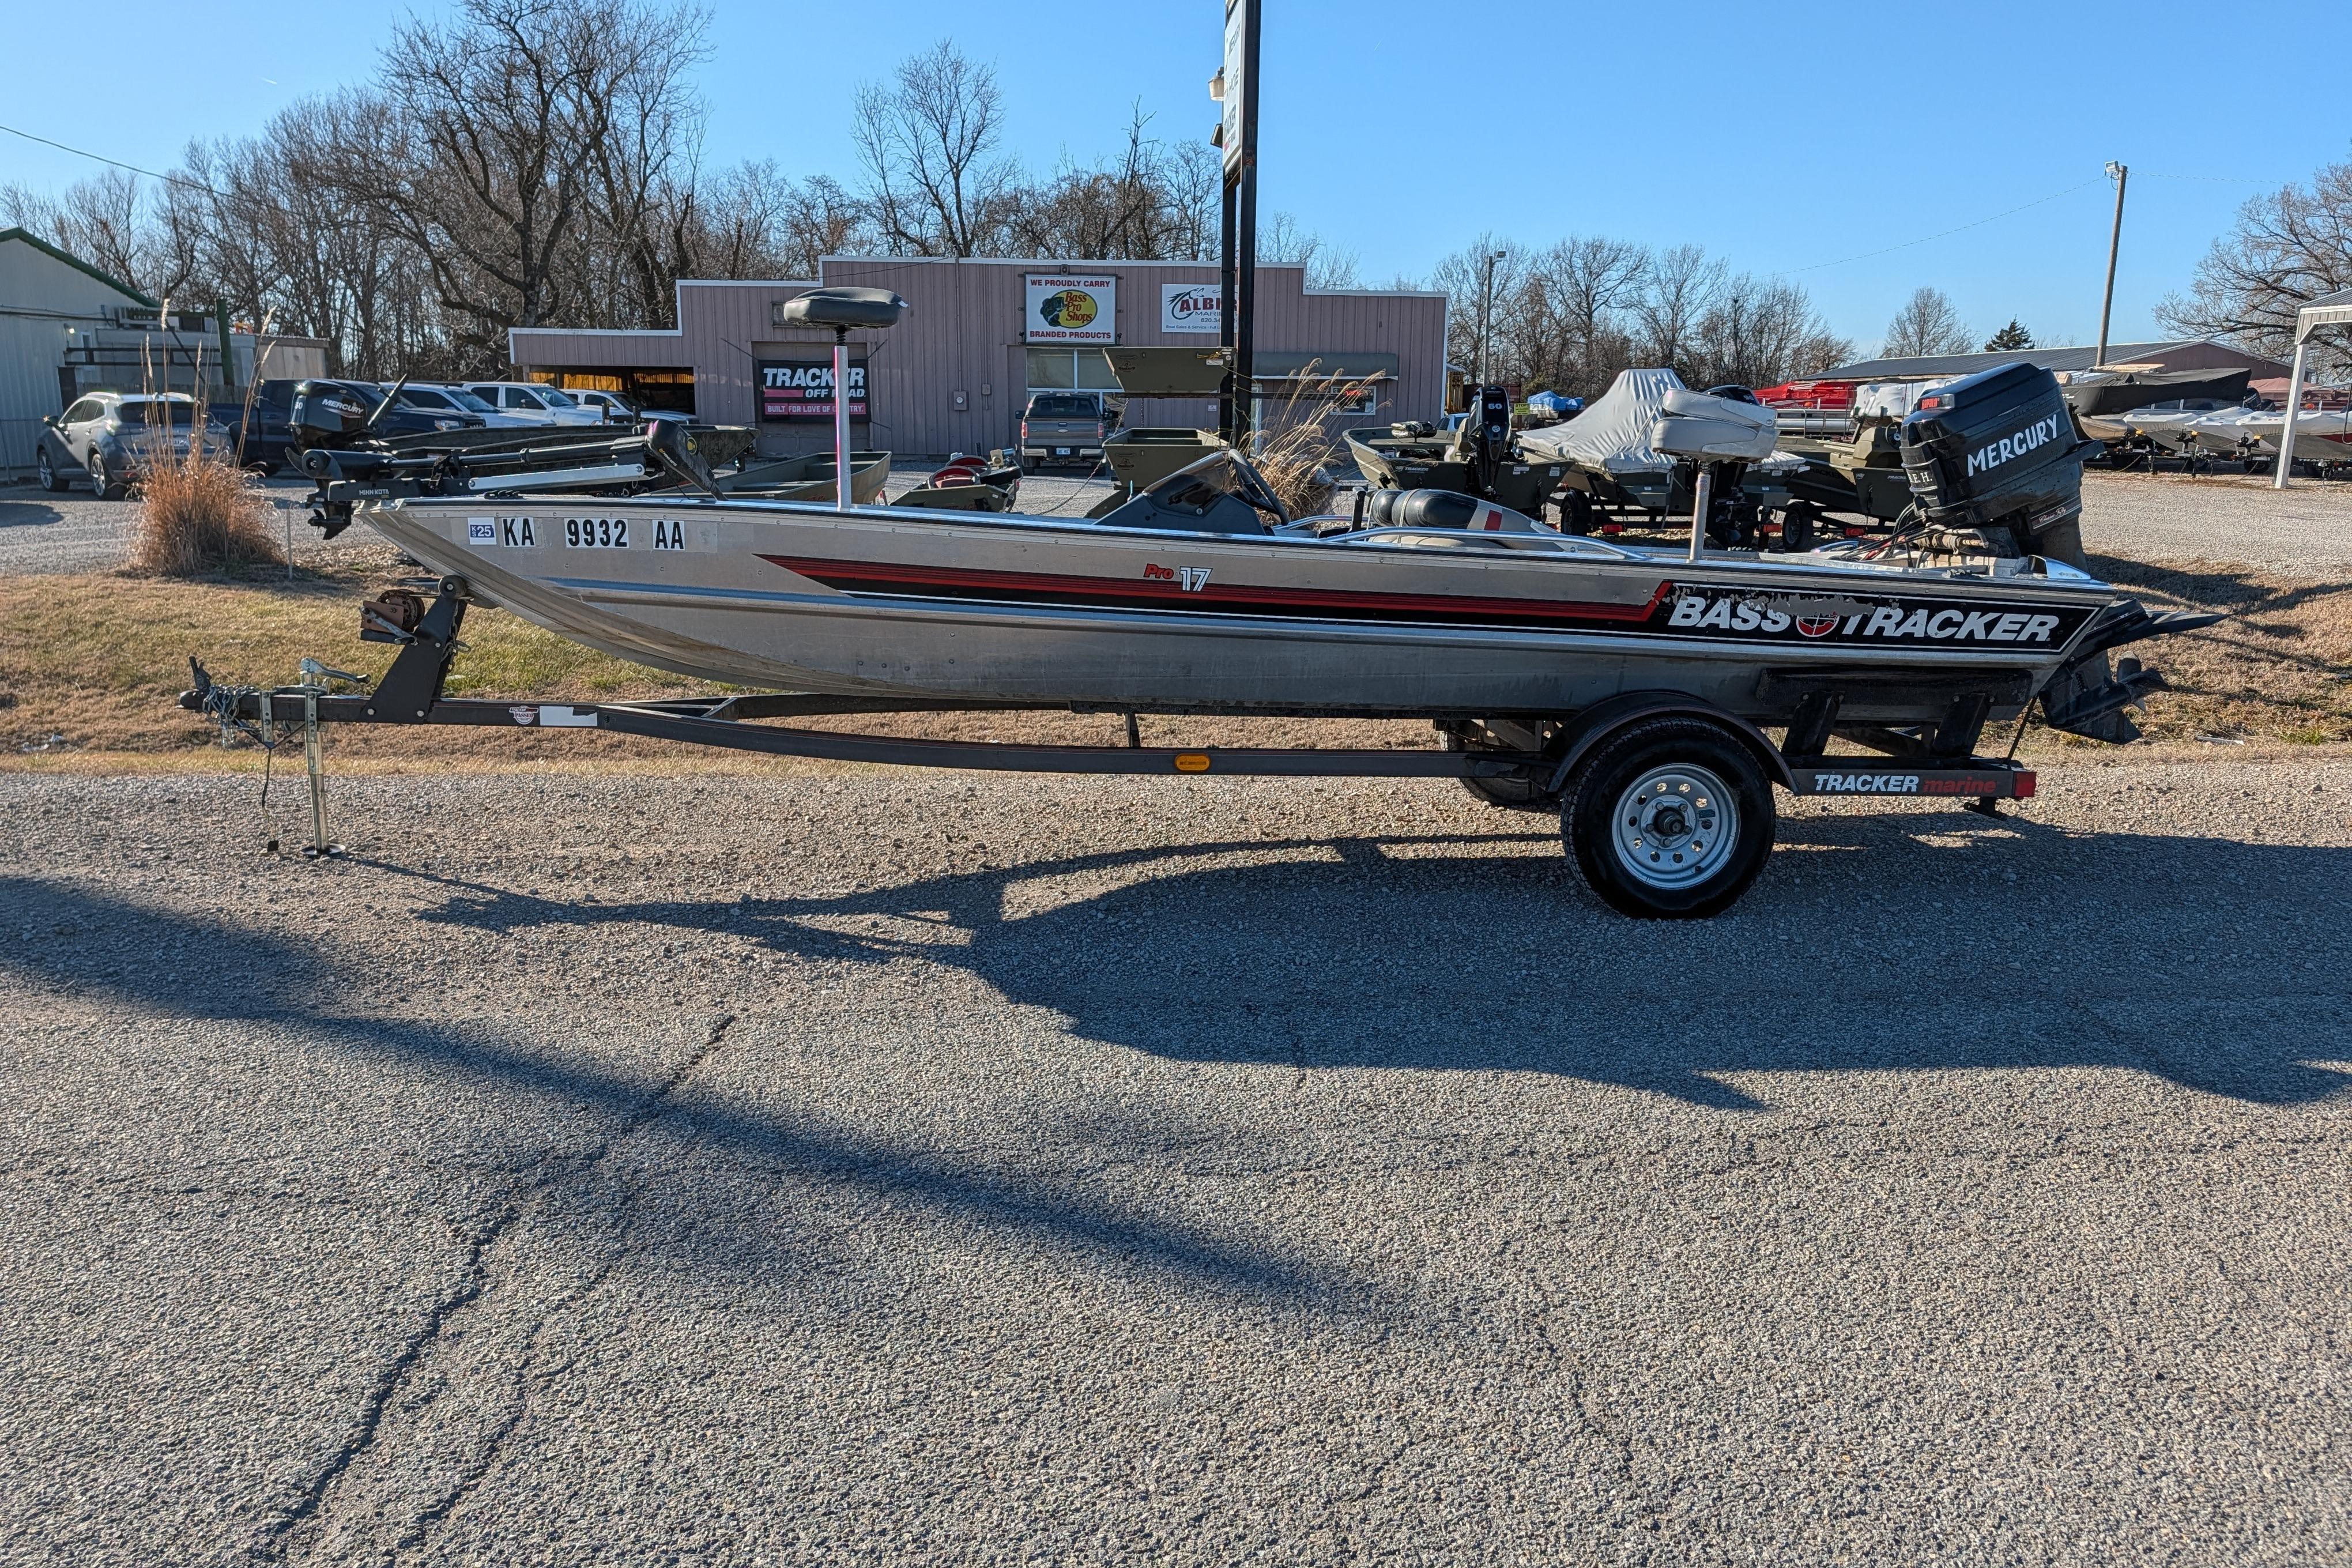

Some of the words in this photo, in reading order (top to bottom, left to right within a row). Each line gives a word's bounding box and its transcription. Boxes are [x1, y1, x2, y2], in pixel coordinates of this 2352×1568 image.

[1065, 292, 1087, 302] Bass
[1066, 301, 1081, 312] Pro
[1065, 311, 1092, 324] Shops
[763, 367, 865, 387] TRACKR
[805, 389, 828, 398] OFF
[322, 398, 364, 414] MERCURY
[1967, 414, 2059, 477] MERCURY
[477, 525, 492, 537] 25
[503, 518, 535, 546] KA
[567, 519, 628, 547] 9932
[655, 521, 684, 550] AA
[1143, 563, 1174, 579] Pro
[1179, 566, 1213, 592] 17
[1667, 596, 1791, 631] BASS
[1842, 605, 2060, 642] TRACKER
[1814, 774, 1920, 793] TRACKER
[1922, 776, 1997, 794] marine
